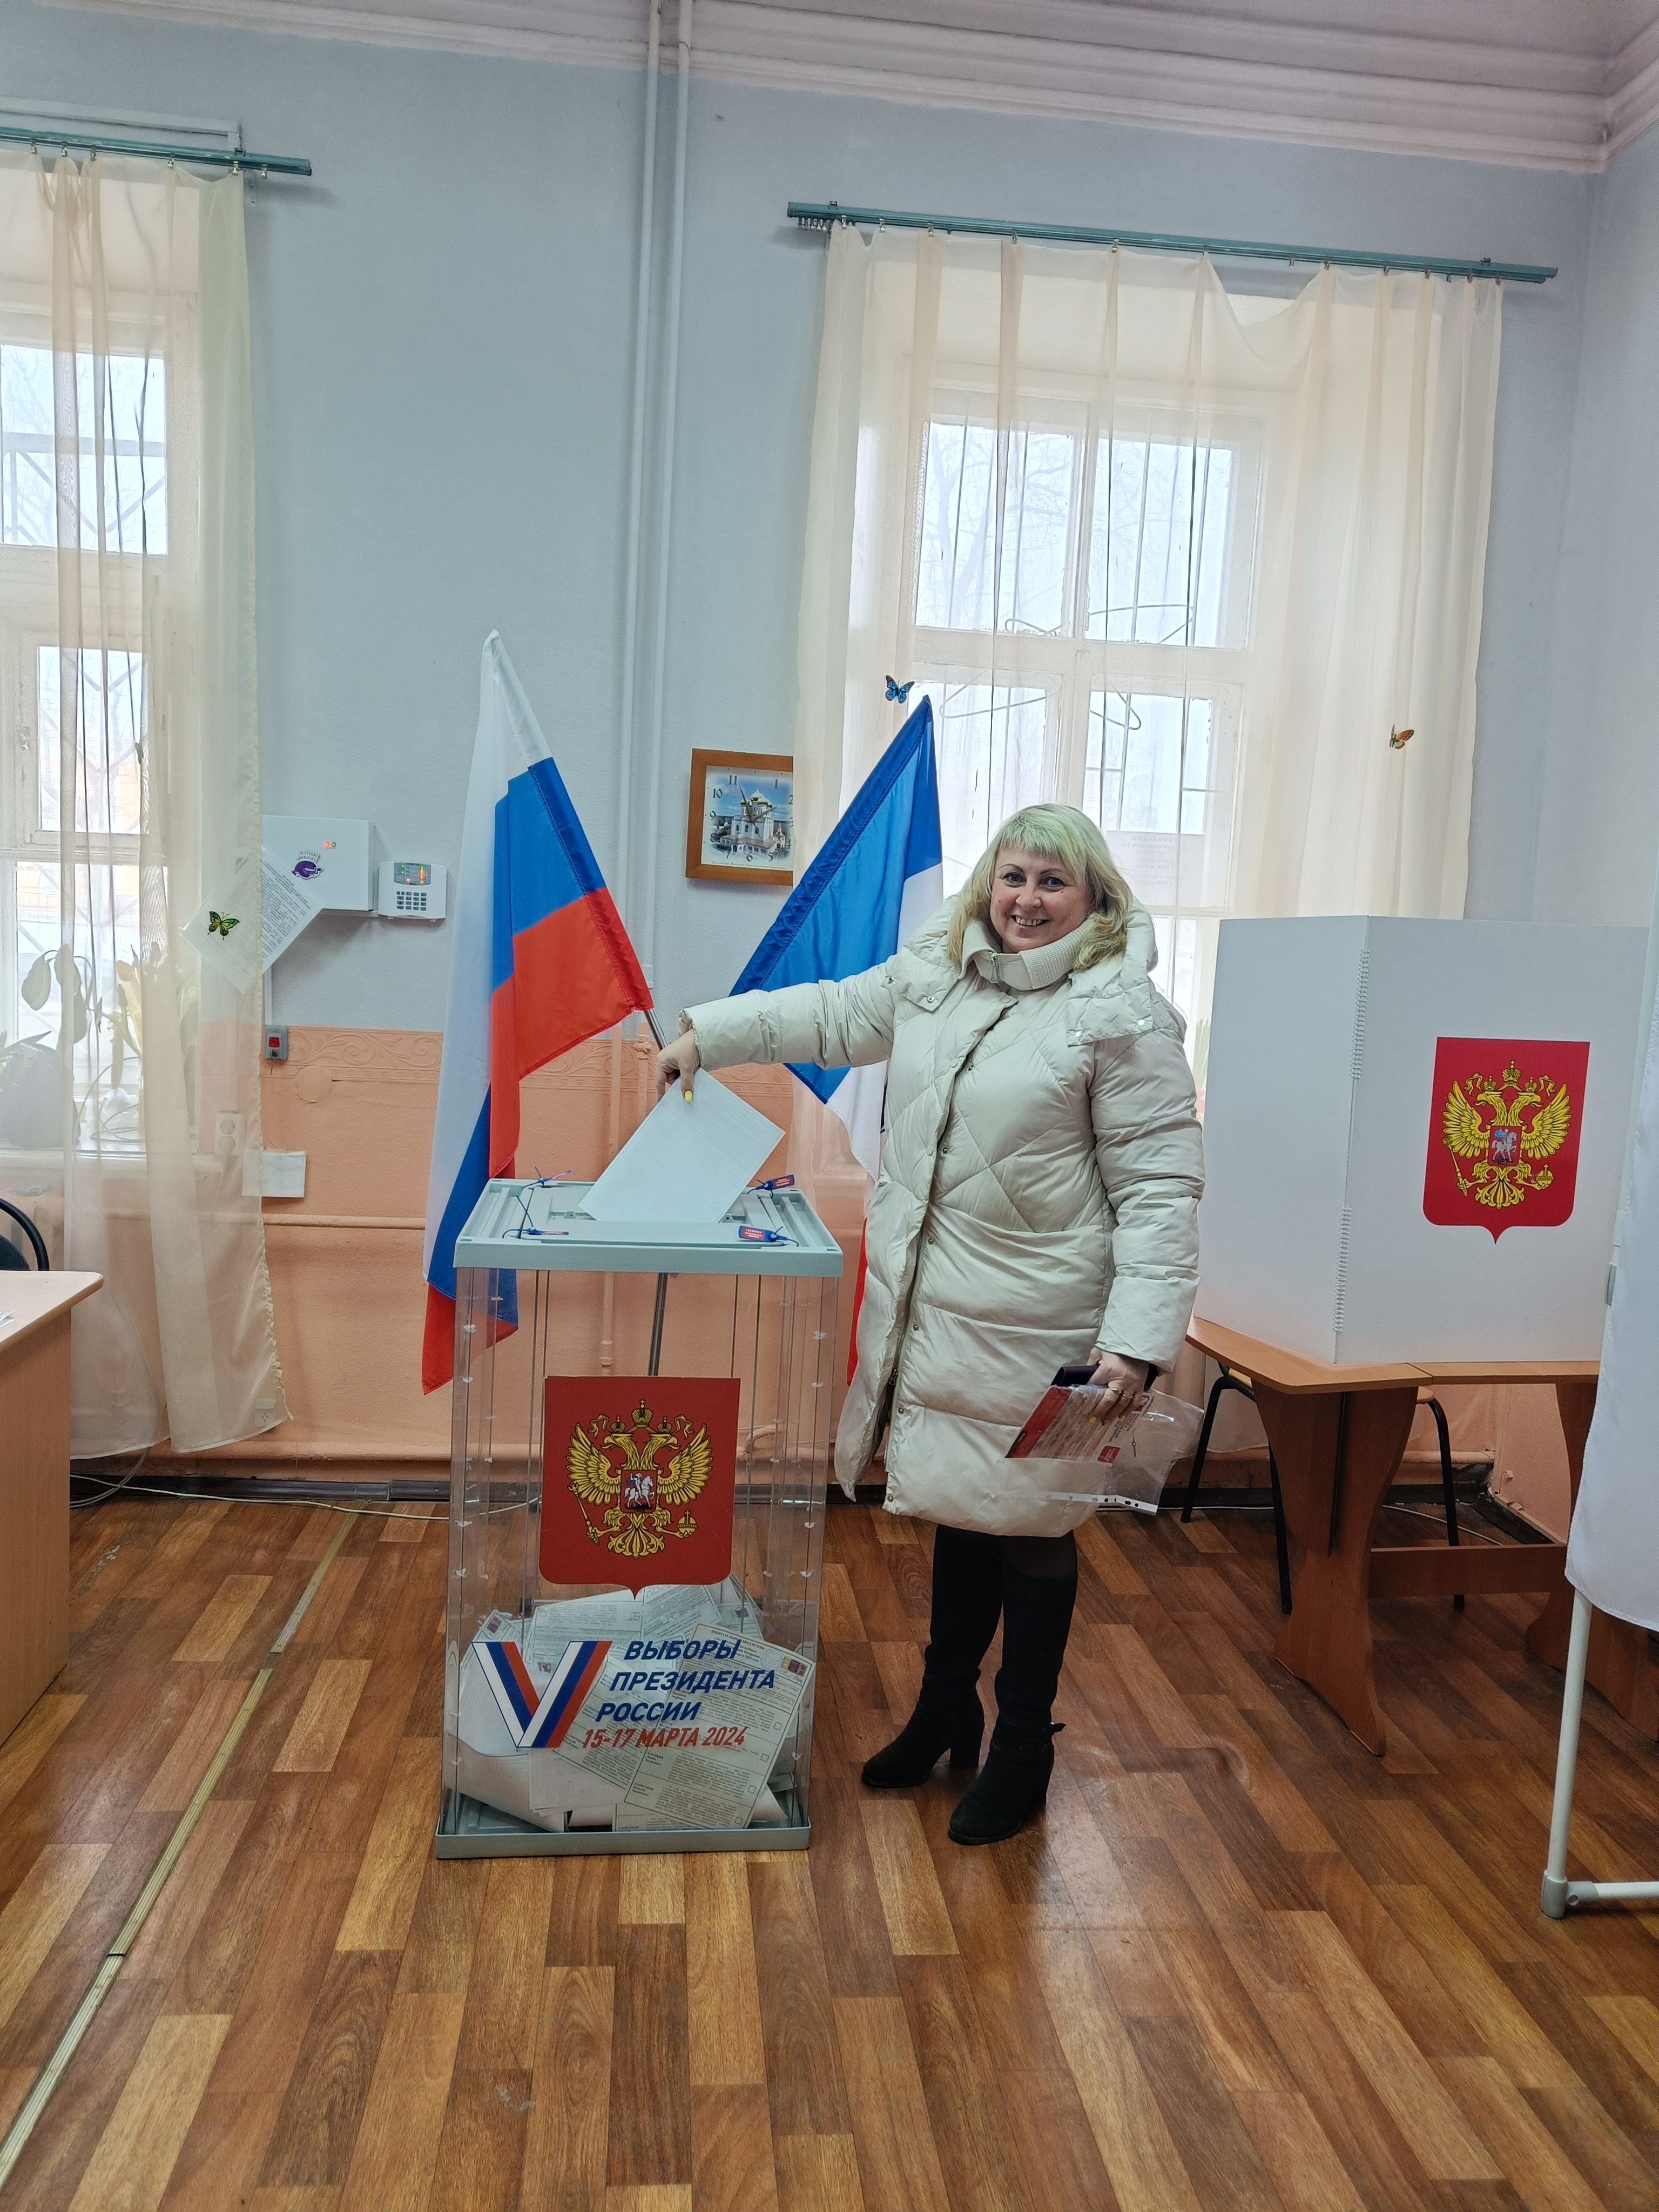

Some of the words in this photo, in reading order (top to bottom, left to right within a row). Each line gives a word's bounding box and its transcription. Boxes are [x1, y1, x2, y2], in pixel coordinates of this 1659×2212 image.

[729, 774, 737, 785] 11
[774, 778, 778, 788] 1
[712, 788, 723, 799] 10
[709, 810, 717, 821] 9
[710, 833, 717, 843] 8
[785, 839, 792, 849] 4
[746, 852, 753, 862] 6
[767, 851, 774, 862] 5
[623, 1640, 743, 1661] ВЫБОРЫ
[609, 1669, 775, 1694] ПРЕЗИДЕНТА
[595, 1702, 702, 1722] РОССИИ
[582, 1729, 636, 1749] 15-17
[635, 1727, 699, 1748] МАРТА
[702, 1726, 750, 1746] 2024
